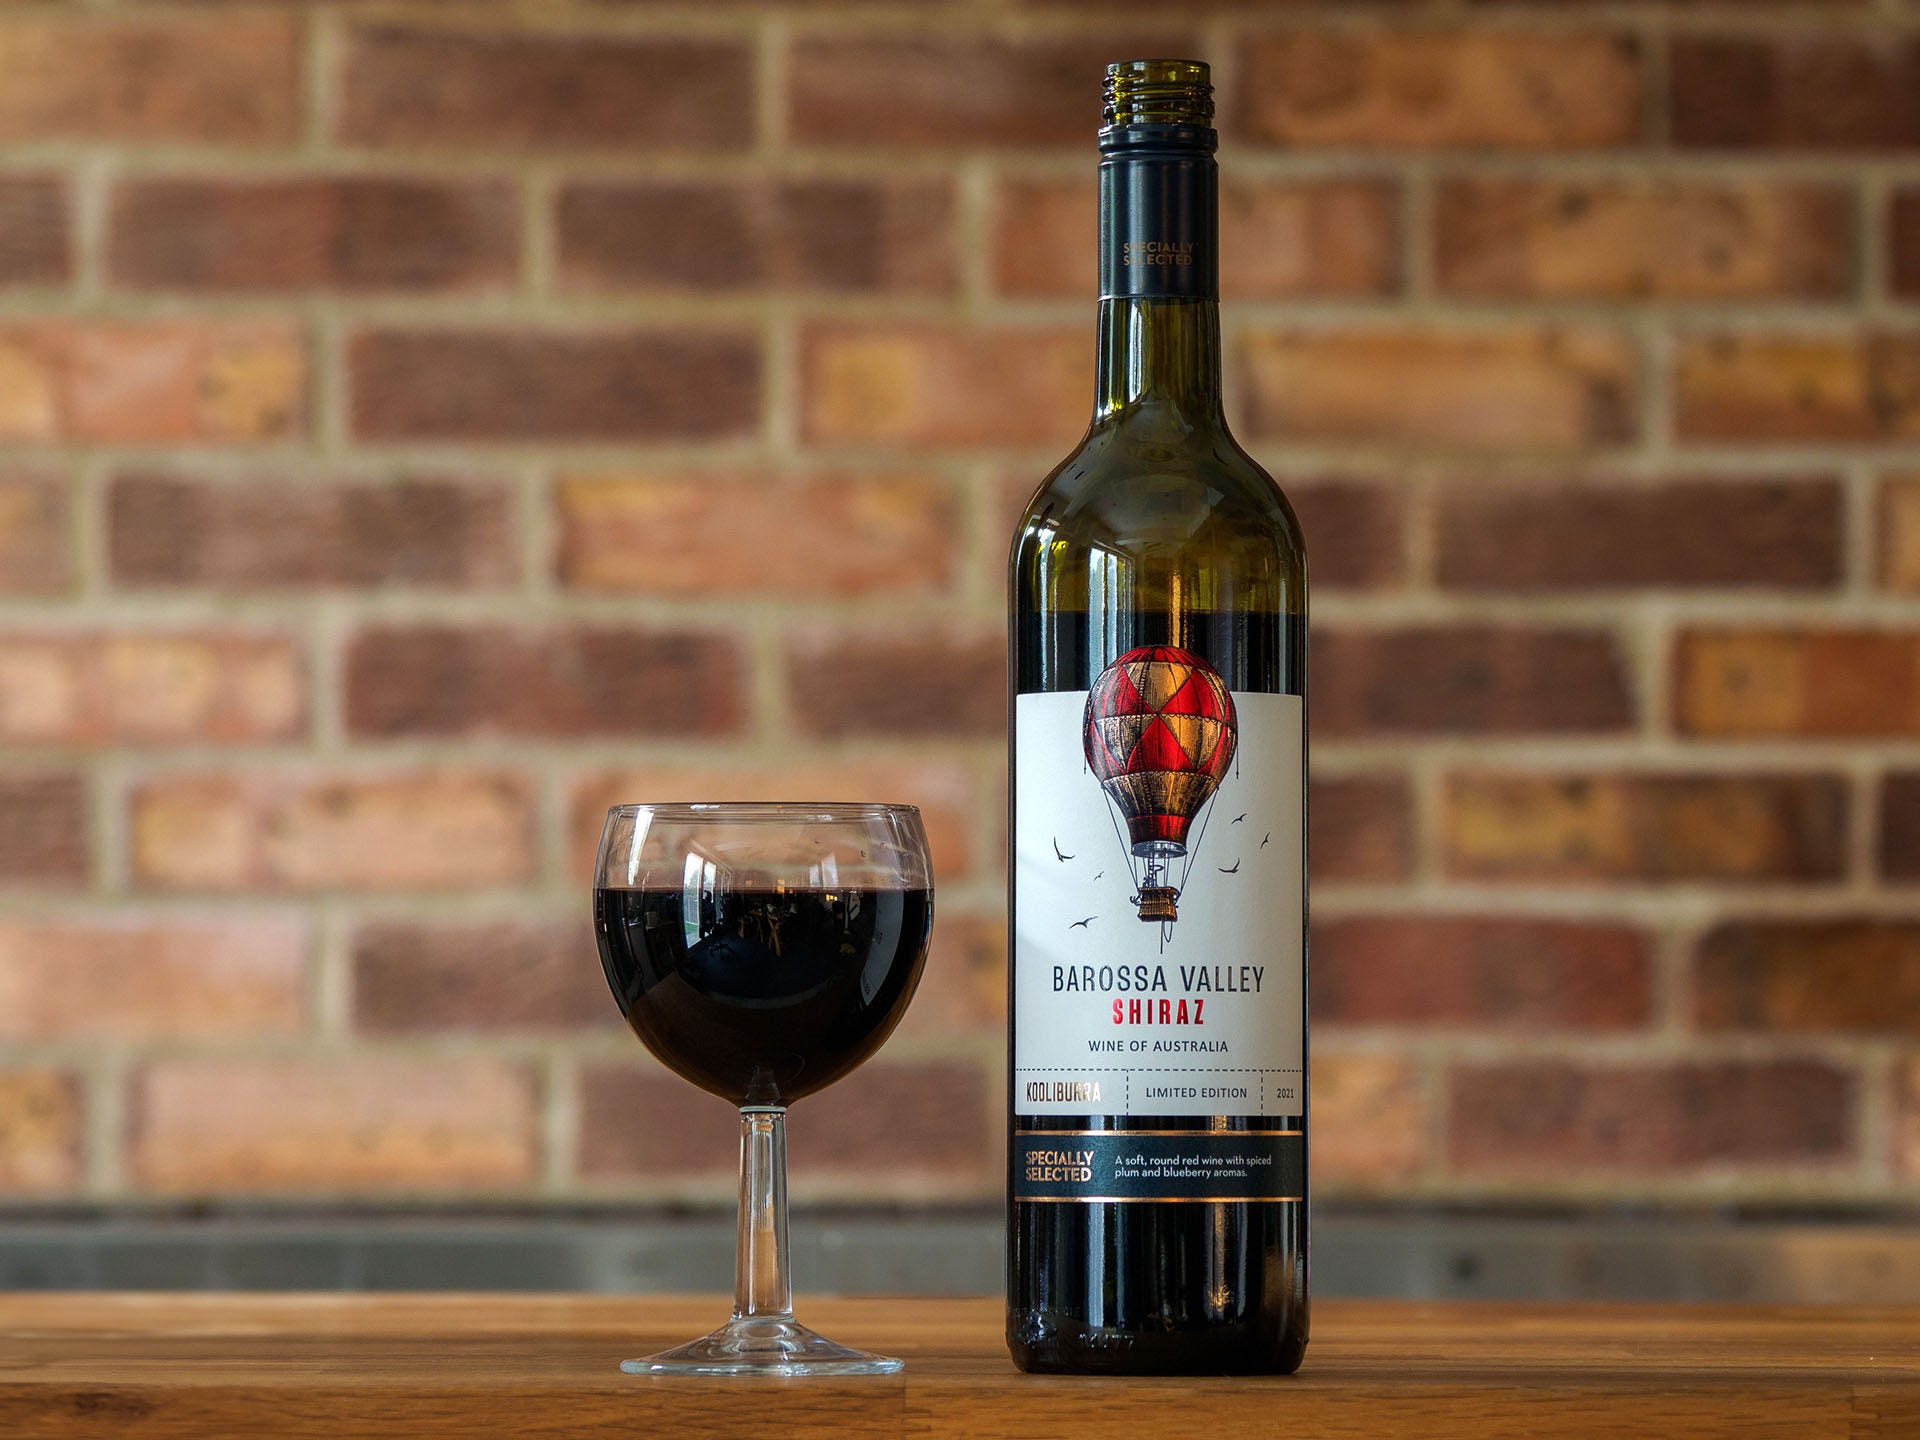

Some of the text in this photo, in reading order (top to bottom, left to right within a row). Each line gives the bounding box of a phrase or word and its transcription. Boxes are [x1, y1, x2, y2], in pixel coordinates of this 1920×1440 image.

[1053, 965, 1265, 993] BAROSSA VALLEY
[1112, 998, 1205, 1026] SHIRAZ
[1088, 1040, 1229, 1053] WINE OF AUSTRALIA
[1026, 1081, 1101, 1103] KOOLIBURRA
[1146, 1087, 1248, 1099] LIMITED EDITION
[1276, 1088, 1295, 1099] 2021
[1025, 1151, 1095, 1166] SPECIALLY
[1115, 1154, 1272, 1168] A soft, round red wine with spiced
[1025, 1167, 1092, 1182] SELECTED
[1115, 1167, 1248, 1180] plum and blueberry aromas.
